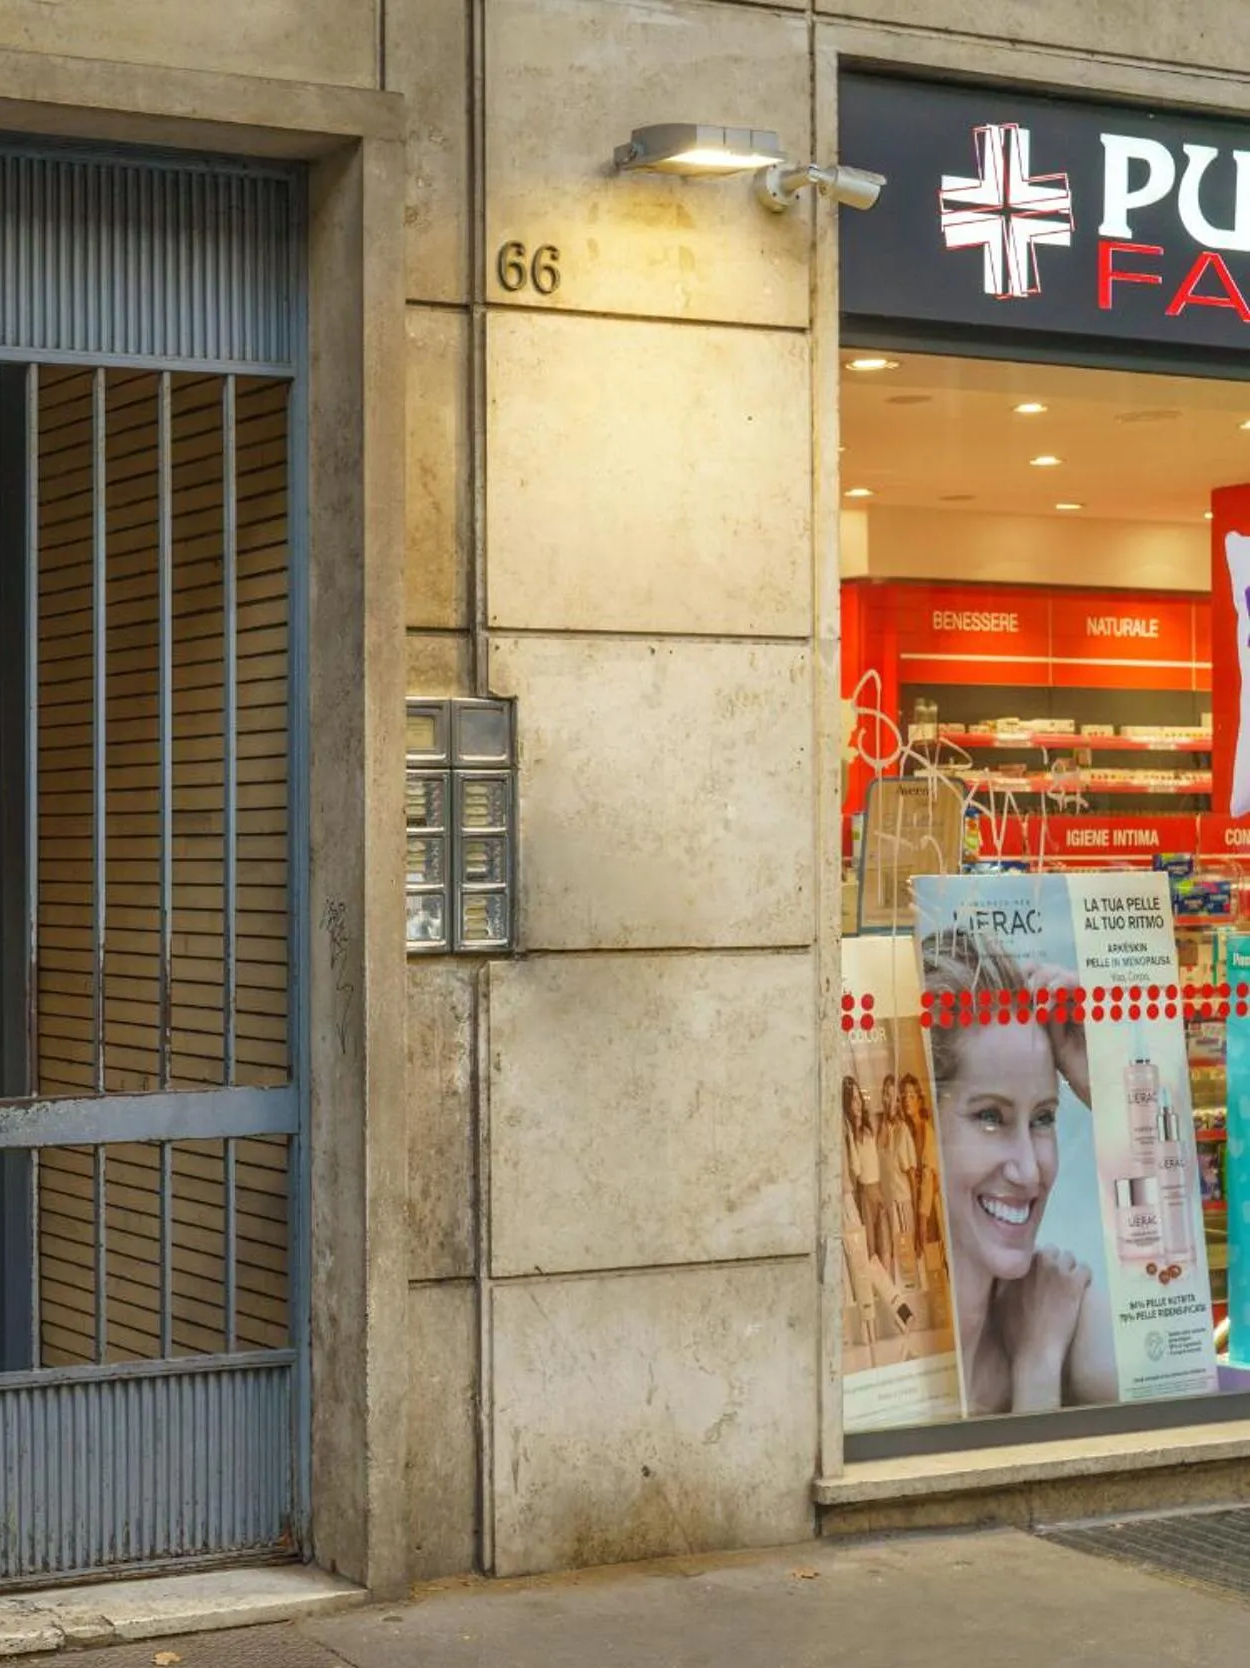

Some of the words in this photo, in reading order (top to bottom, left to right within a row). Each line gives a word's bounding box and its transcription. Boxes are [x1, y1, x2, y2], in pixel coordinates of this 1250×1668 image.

[1097, 132, 1250, 253] PU
[497, 240, 559, 295] 66
[1097, 239, 1250, 323] FA
[933, 610, 1019, 633] BENESSERE
[1086, 616, 1159, 639] NATURALE
[1066, 829, 1109, 847] IGIENE
[1113, 828, 1160, 847] INTIMA
[1084, 898, 1099, 912] LA
[1100, 898, 1125, 912] TUA
[1126, 897, 1161, 911] PELLE
[1084, 916, 1099, 930] AL
[1101, 916, 1125, 930] TUO
[1128, 915, 1164, 929] RITMO
[1086, 957, 1110, 968] PELLE
[1111, 957, 1120, 968] IN
[1122, 955, 1171, 967] MENOPAUSA
